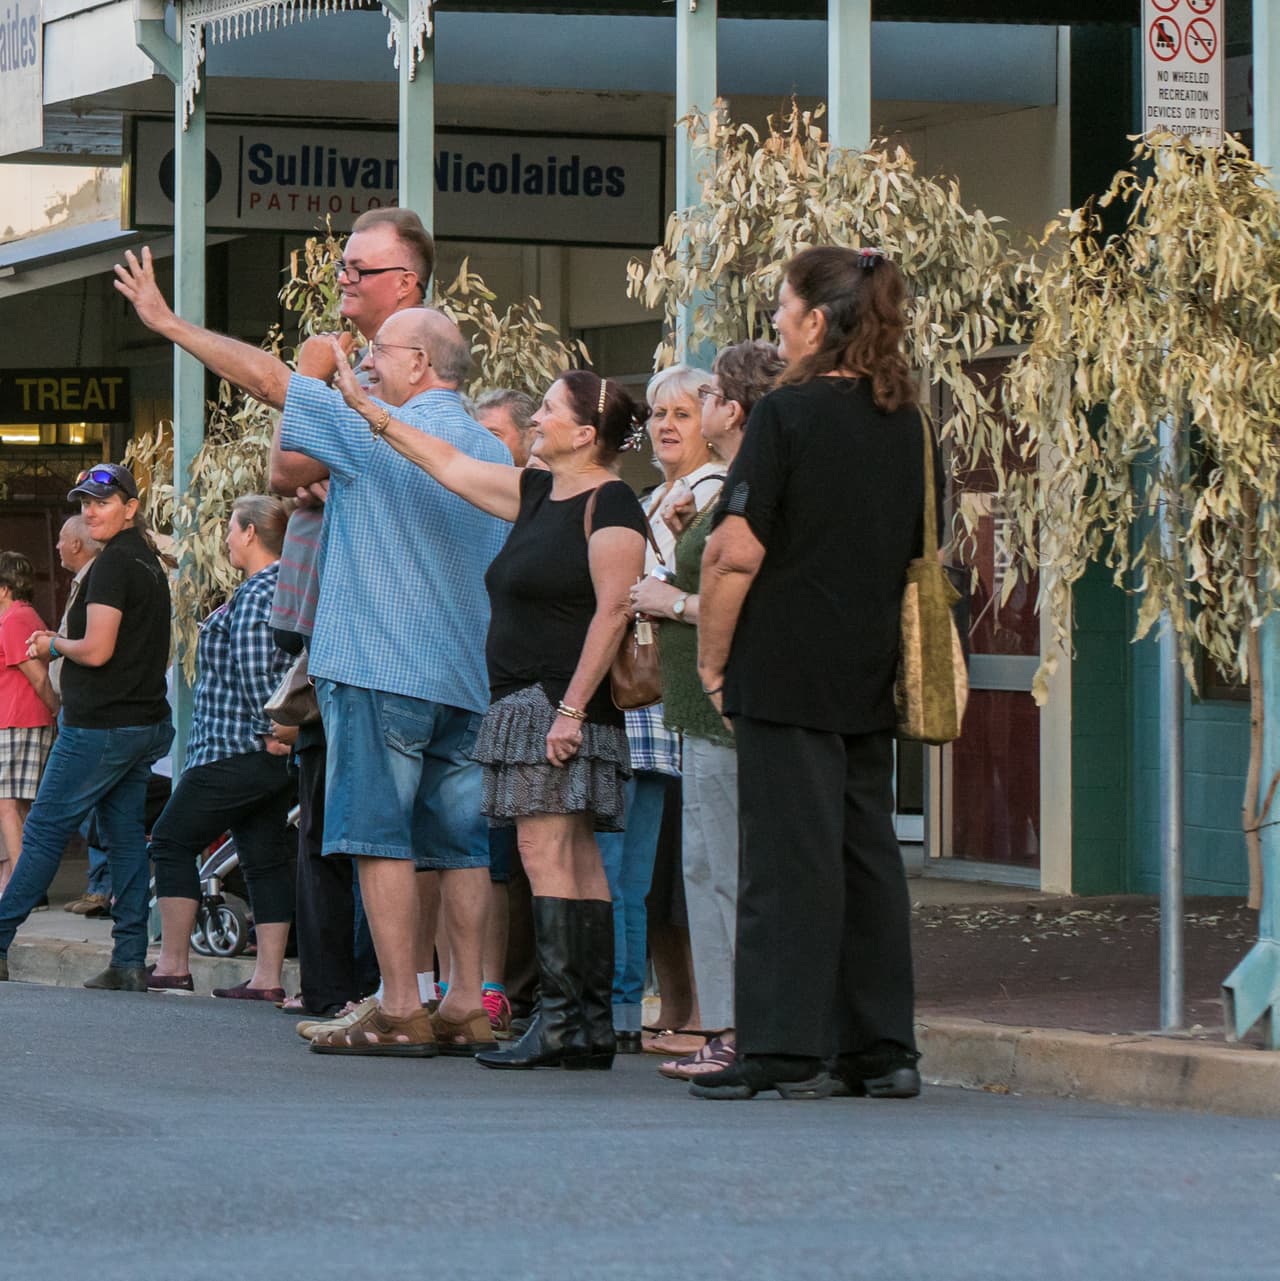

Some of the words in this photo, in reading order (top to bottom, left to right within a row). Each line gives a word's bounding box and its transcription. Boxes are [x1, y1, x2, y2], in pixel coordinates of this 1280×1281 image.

[1157, 70, 1169, 82] NO
[1172, 71, 1209, 84] WHEELED
[1159, 88, 1209, 101] RECREATION
[1147, 105, 1182, 118] DEVICES
[1185, 107, 1196, 119] OR
[1200, 108, 1220, 120] TOYS
[248, 142, 400, 189] Sullivan
[435, 150, 626, 197] Nicolaides
[249, 192, 399, 214] PATHOLO
[15, 376, 123, 411] TREAT
